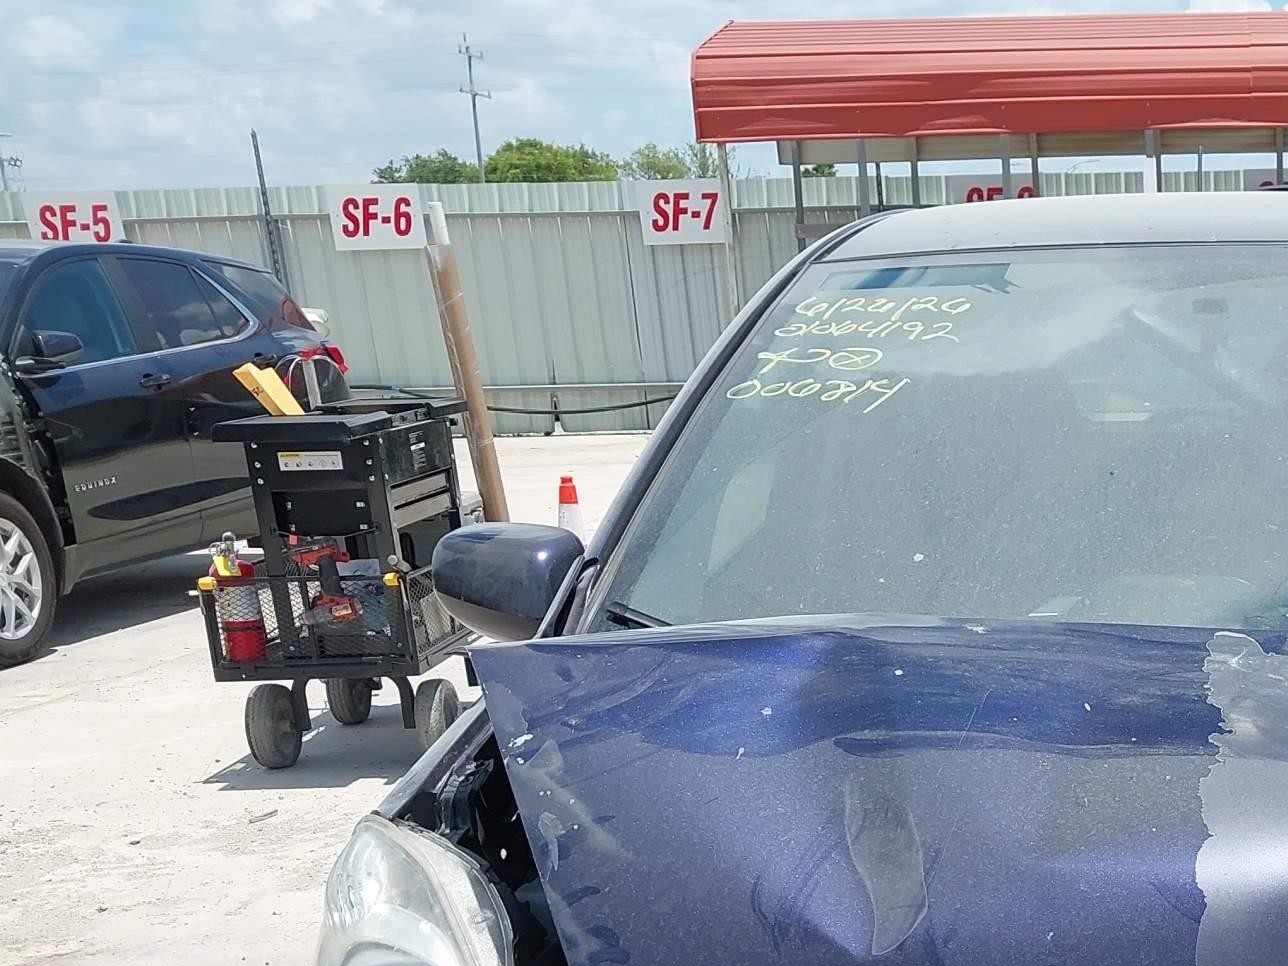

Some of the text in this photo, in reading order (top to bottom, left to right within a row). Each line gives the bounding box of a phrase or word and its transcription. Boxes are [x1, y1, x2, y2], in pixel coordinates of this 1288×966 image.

[39, 204, 112, 242] SF-5
[341, 197, 413, 238] SF-6
[651, 191, 718, 232] SF-7
